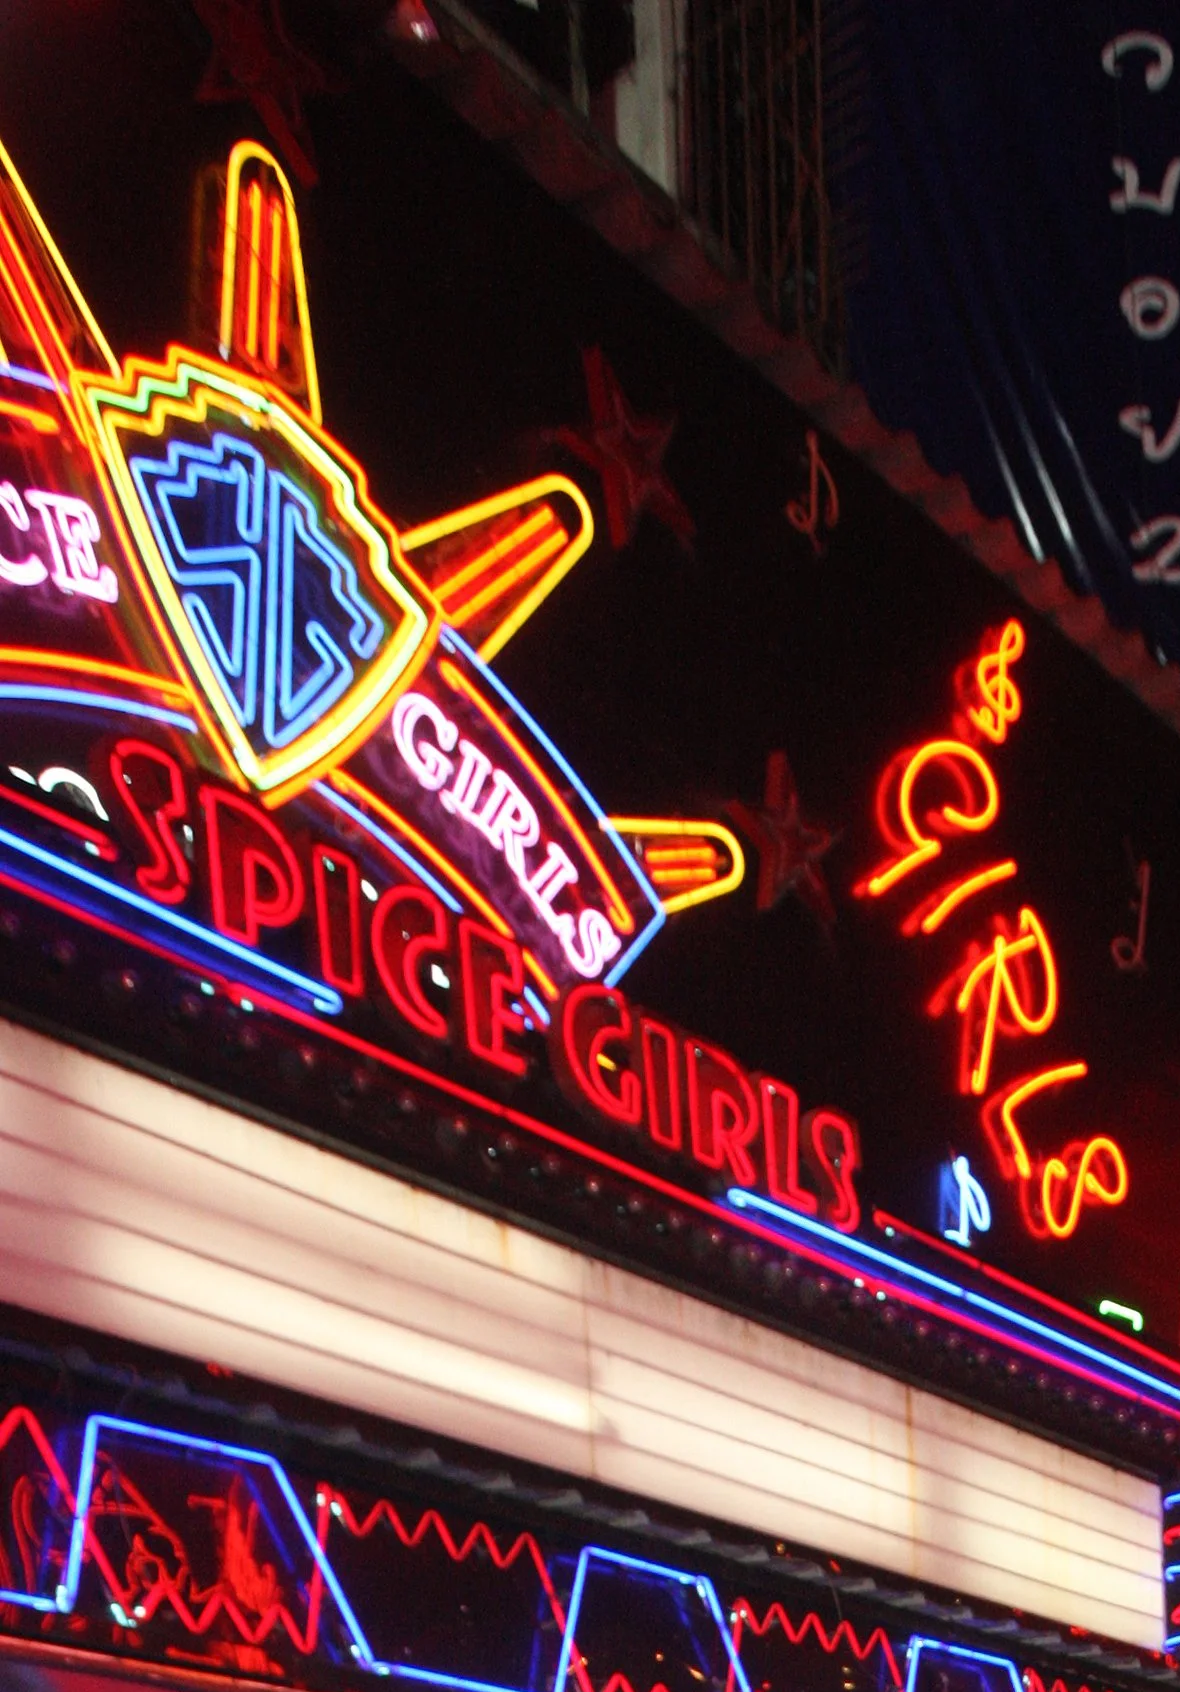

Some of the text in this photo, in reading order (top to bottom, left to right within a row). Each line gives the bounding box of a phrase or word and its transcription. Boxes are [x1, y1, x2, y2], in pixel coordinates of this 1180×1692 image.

[108, 737, 862, 1234] SPICE GIRLS
[391, 691, 621, 981] GIRLS
[862, 738, 1130, 1240] GIRLS
